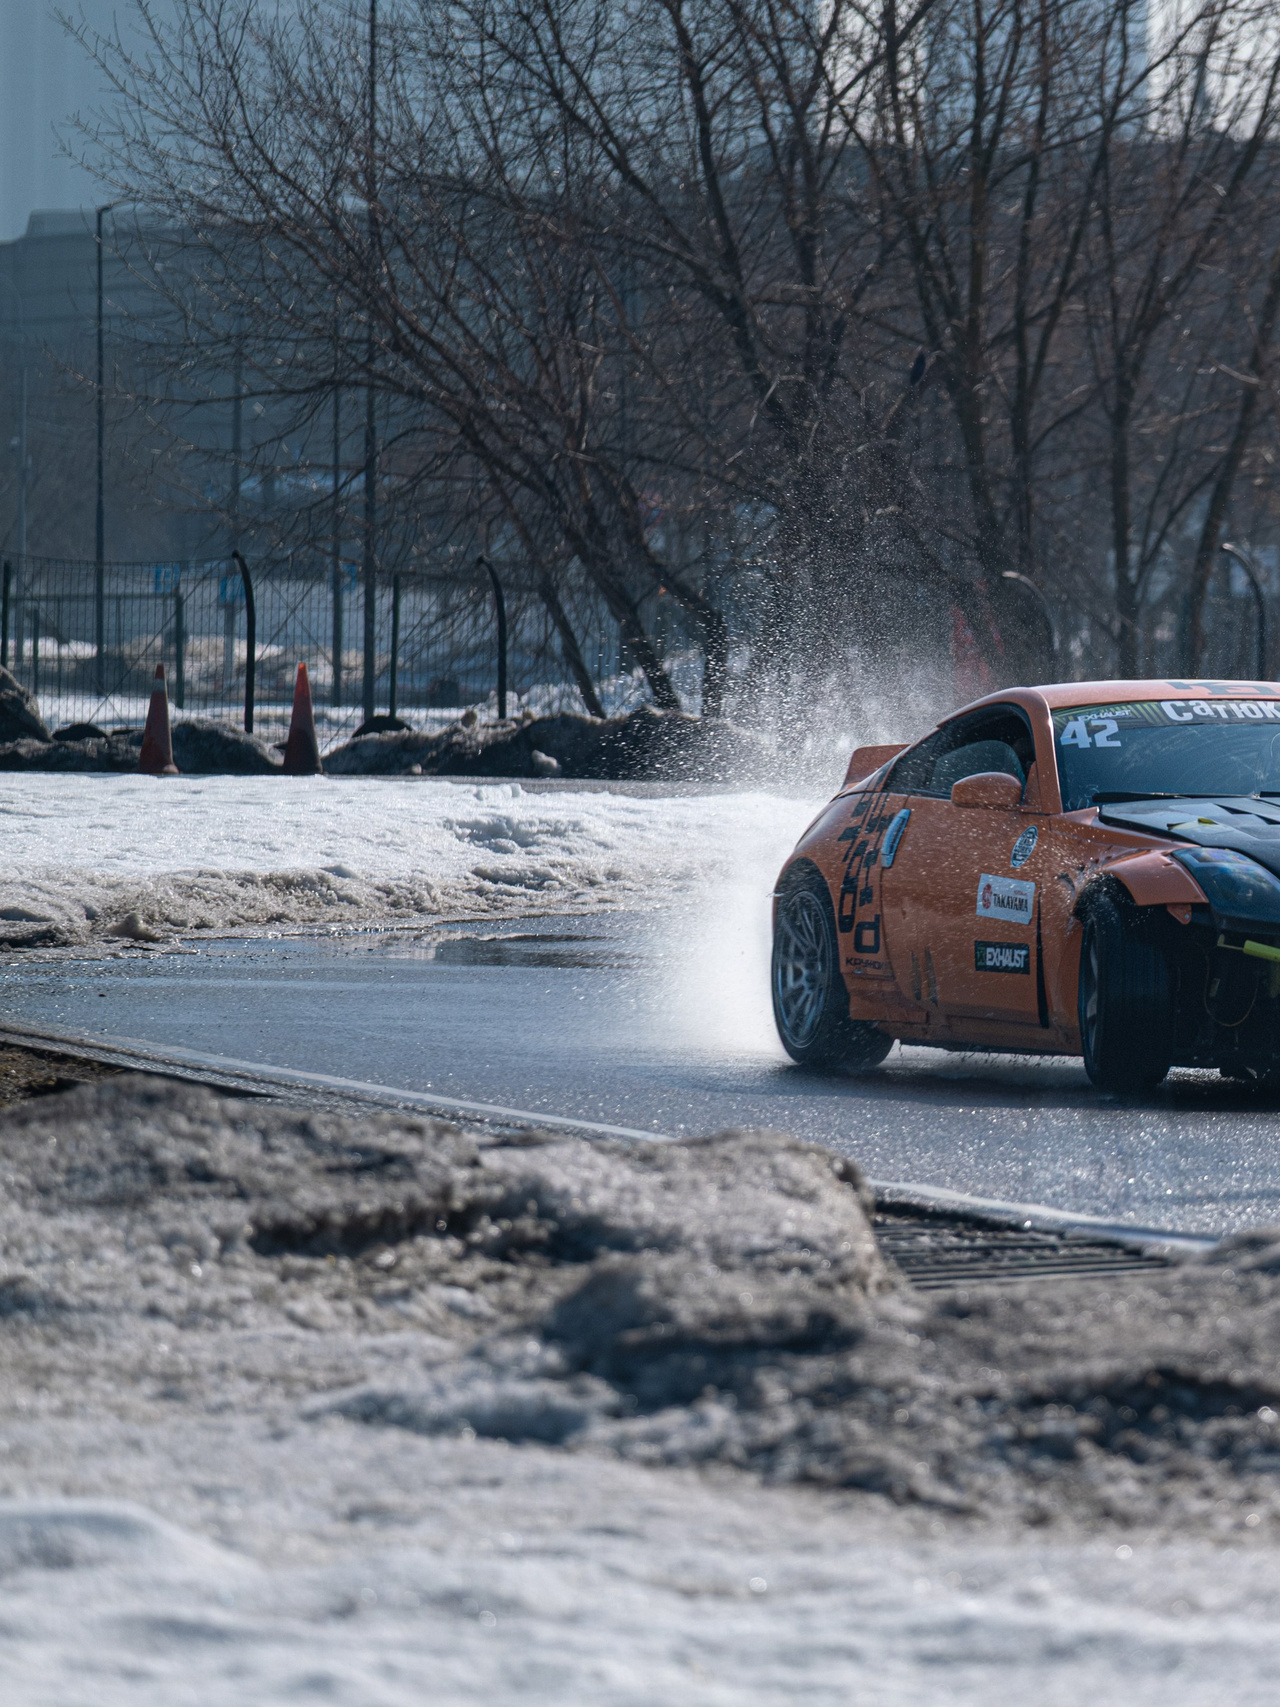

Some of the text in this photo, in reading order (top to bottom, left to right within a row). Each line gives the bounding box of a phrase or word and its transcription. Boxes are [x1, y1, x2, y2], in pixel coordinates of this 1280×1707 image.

[1060, 719, 1121, 748] 42
[993, 893, 1029, 912] TAKAYAMA
[986, 947, 1028, 968] EXHAUST
